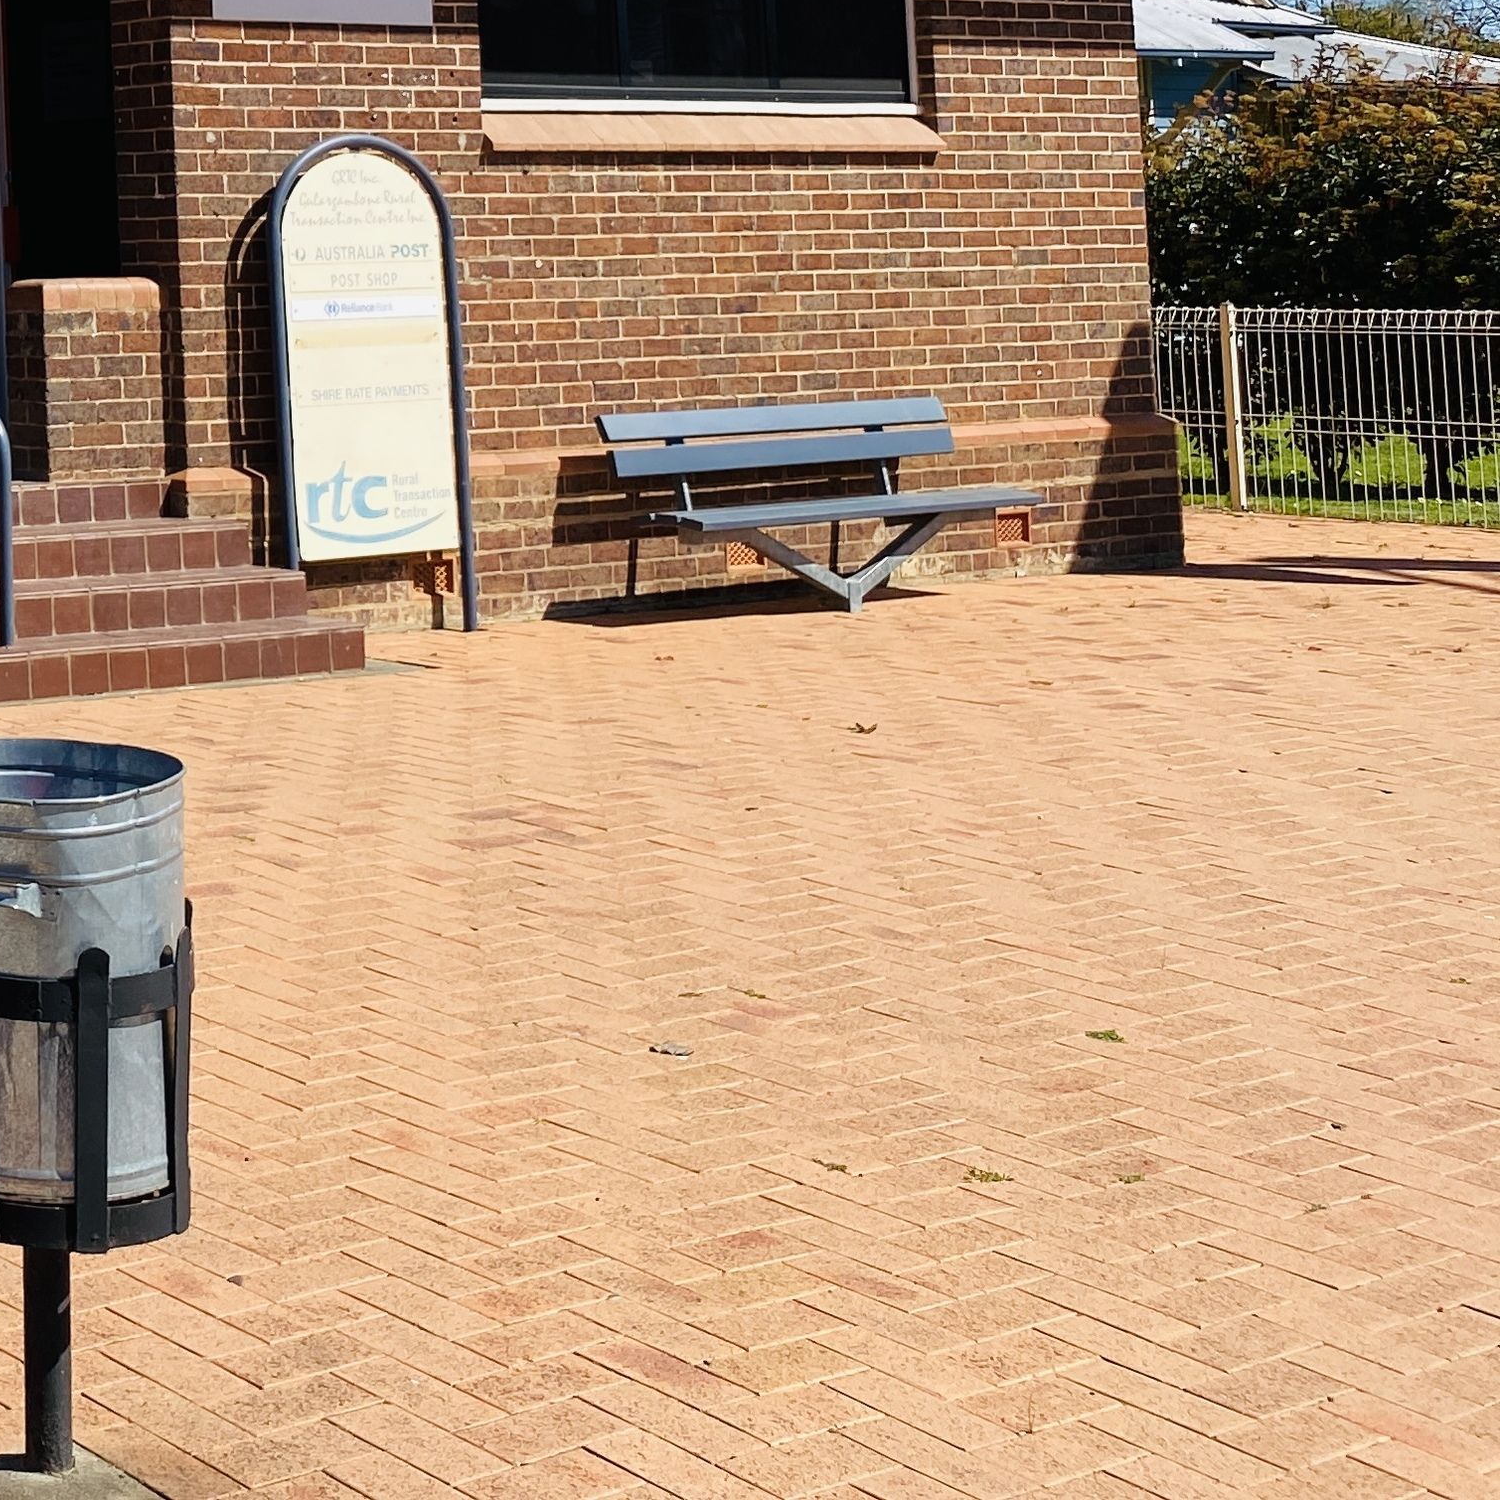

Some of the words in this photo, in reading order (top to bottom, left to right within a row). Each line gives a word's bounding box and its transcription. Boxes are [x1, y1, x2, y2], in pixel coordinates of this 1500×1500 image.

[315, 246, 386, 261] AUSTRALIA
[390, 243, 429, 259] POST
[331, 273, 360, 287] POST
[366, 272, 398, 286] SHOP
[311, 388, 342, 401] SHIRE
[345, 386, 372, 399] RATE
[375, 383, 429, 399] PAYMENTS
[392, 472, 418, 485] Rural
[305, 460, 388, 523] rtc
[393, 487, 451, 502] Transaction
